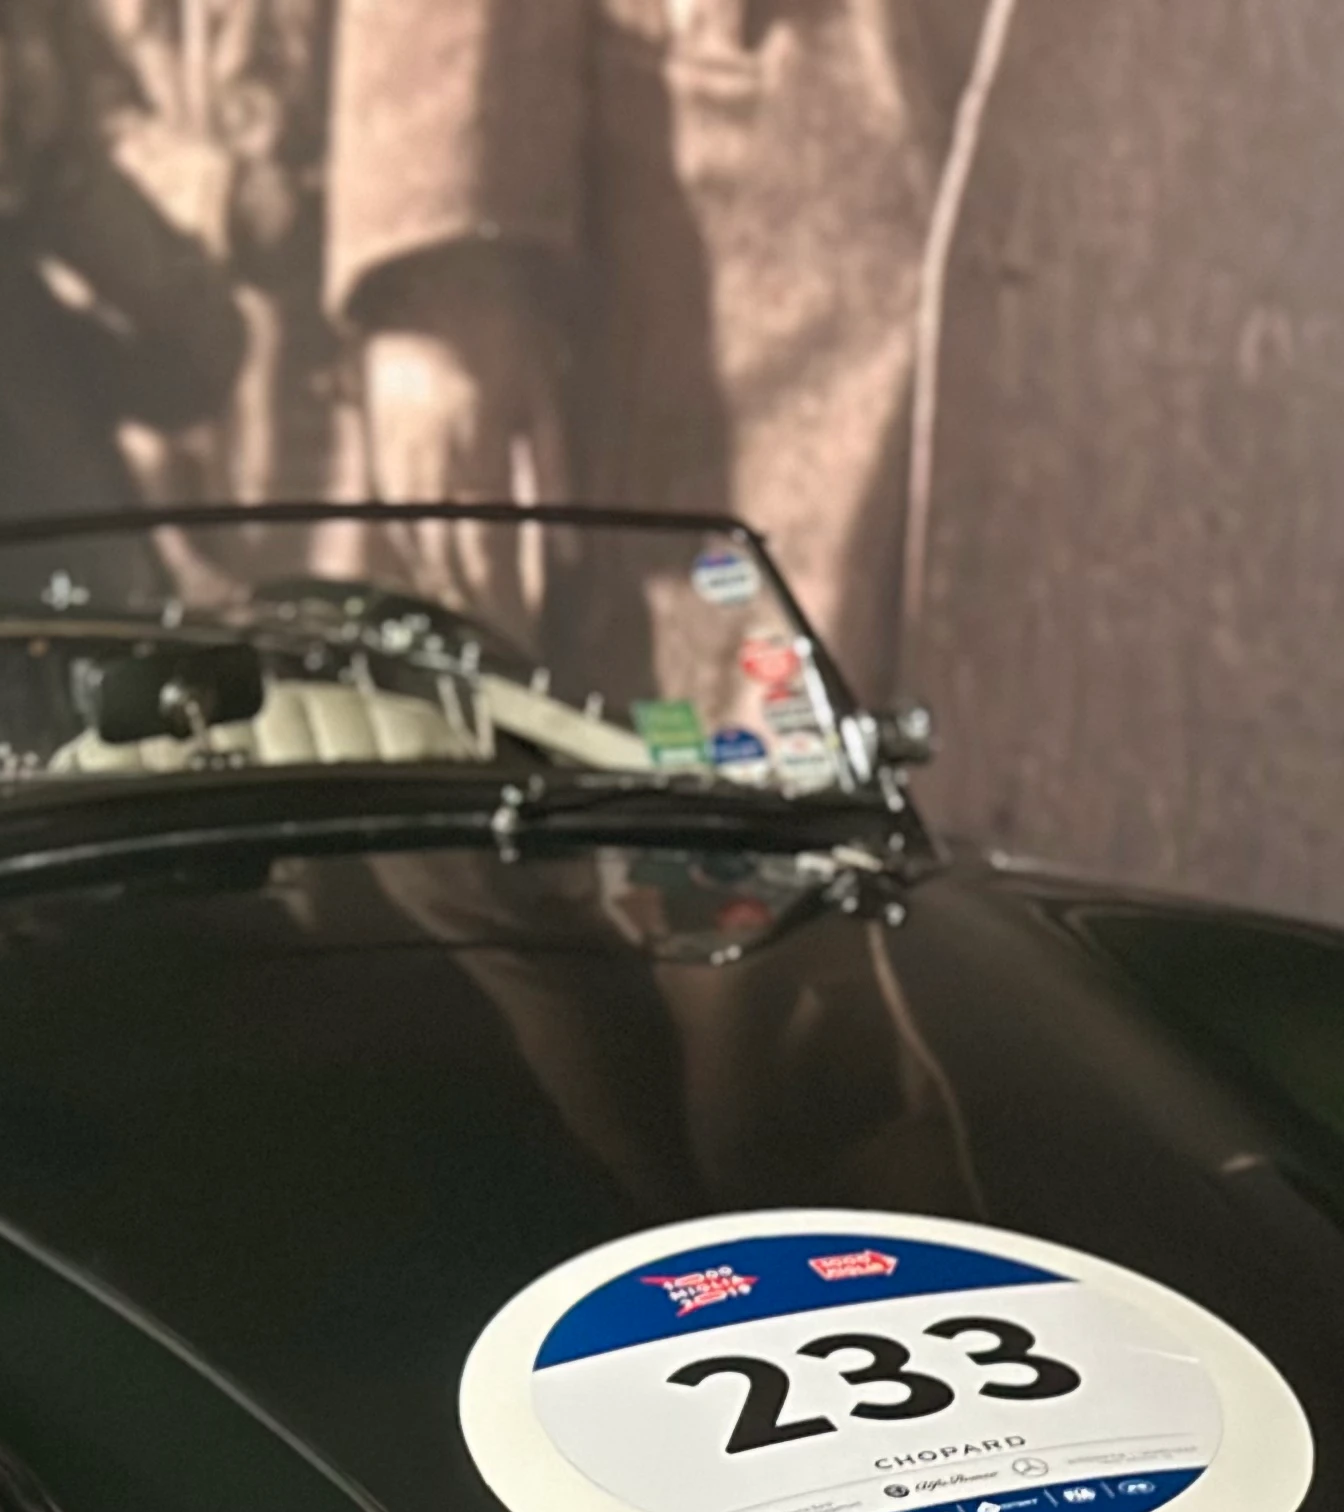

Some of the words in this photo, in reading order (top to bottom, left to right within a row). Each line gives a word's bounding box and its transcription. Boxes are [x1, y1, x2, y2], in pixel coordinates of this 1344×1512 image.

[662, 1265, 733, 1290] 1000
[668, 1275, 746, 1302] MIGLIA
[679, 1283, 752, 1310] 2019
[666, 1316, 1082, 1455] 233
[874, 1435, 1026, 1470] CHOPARD
